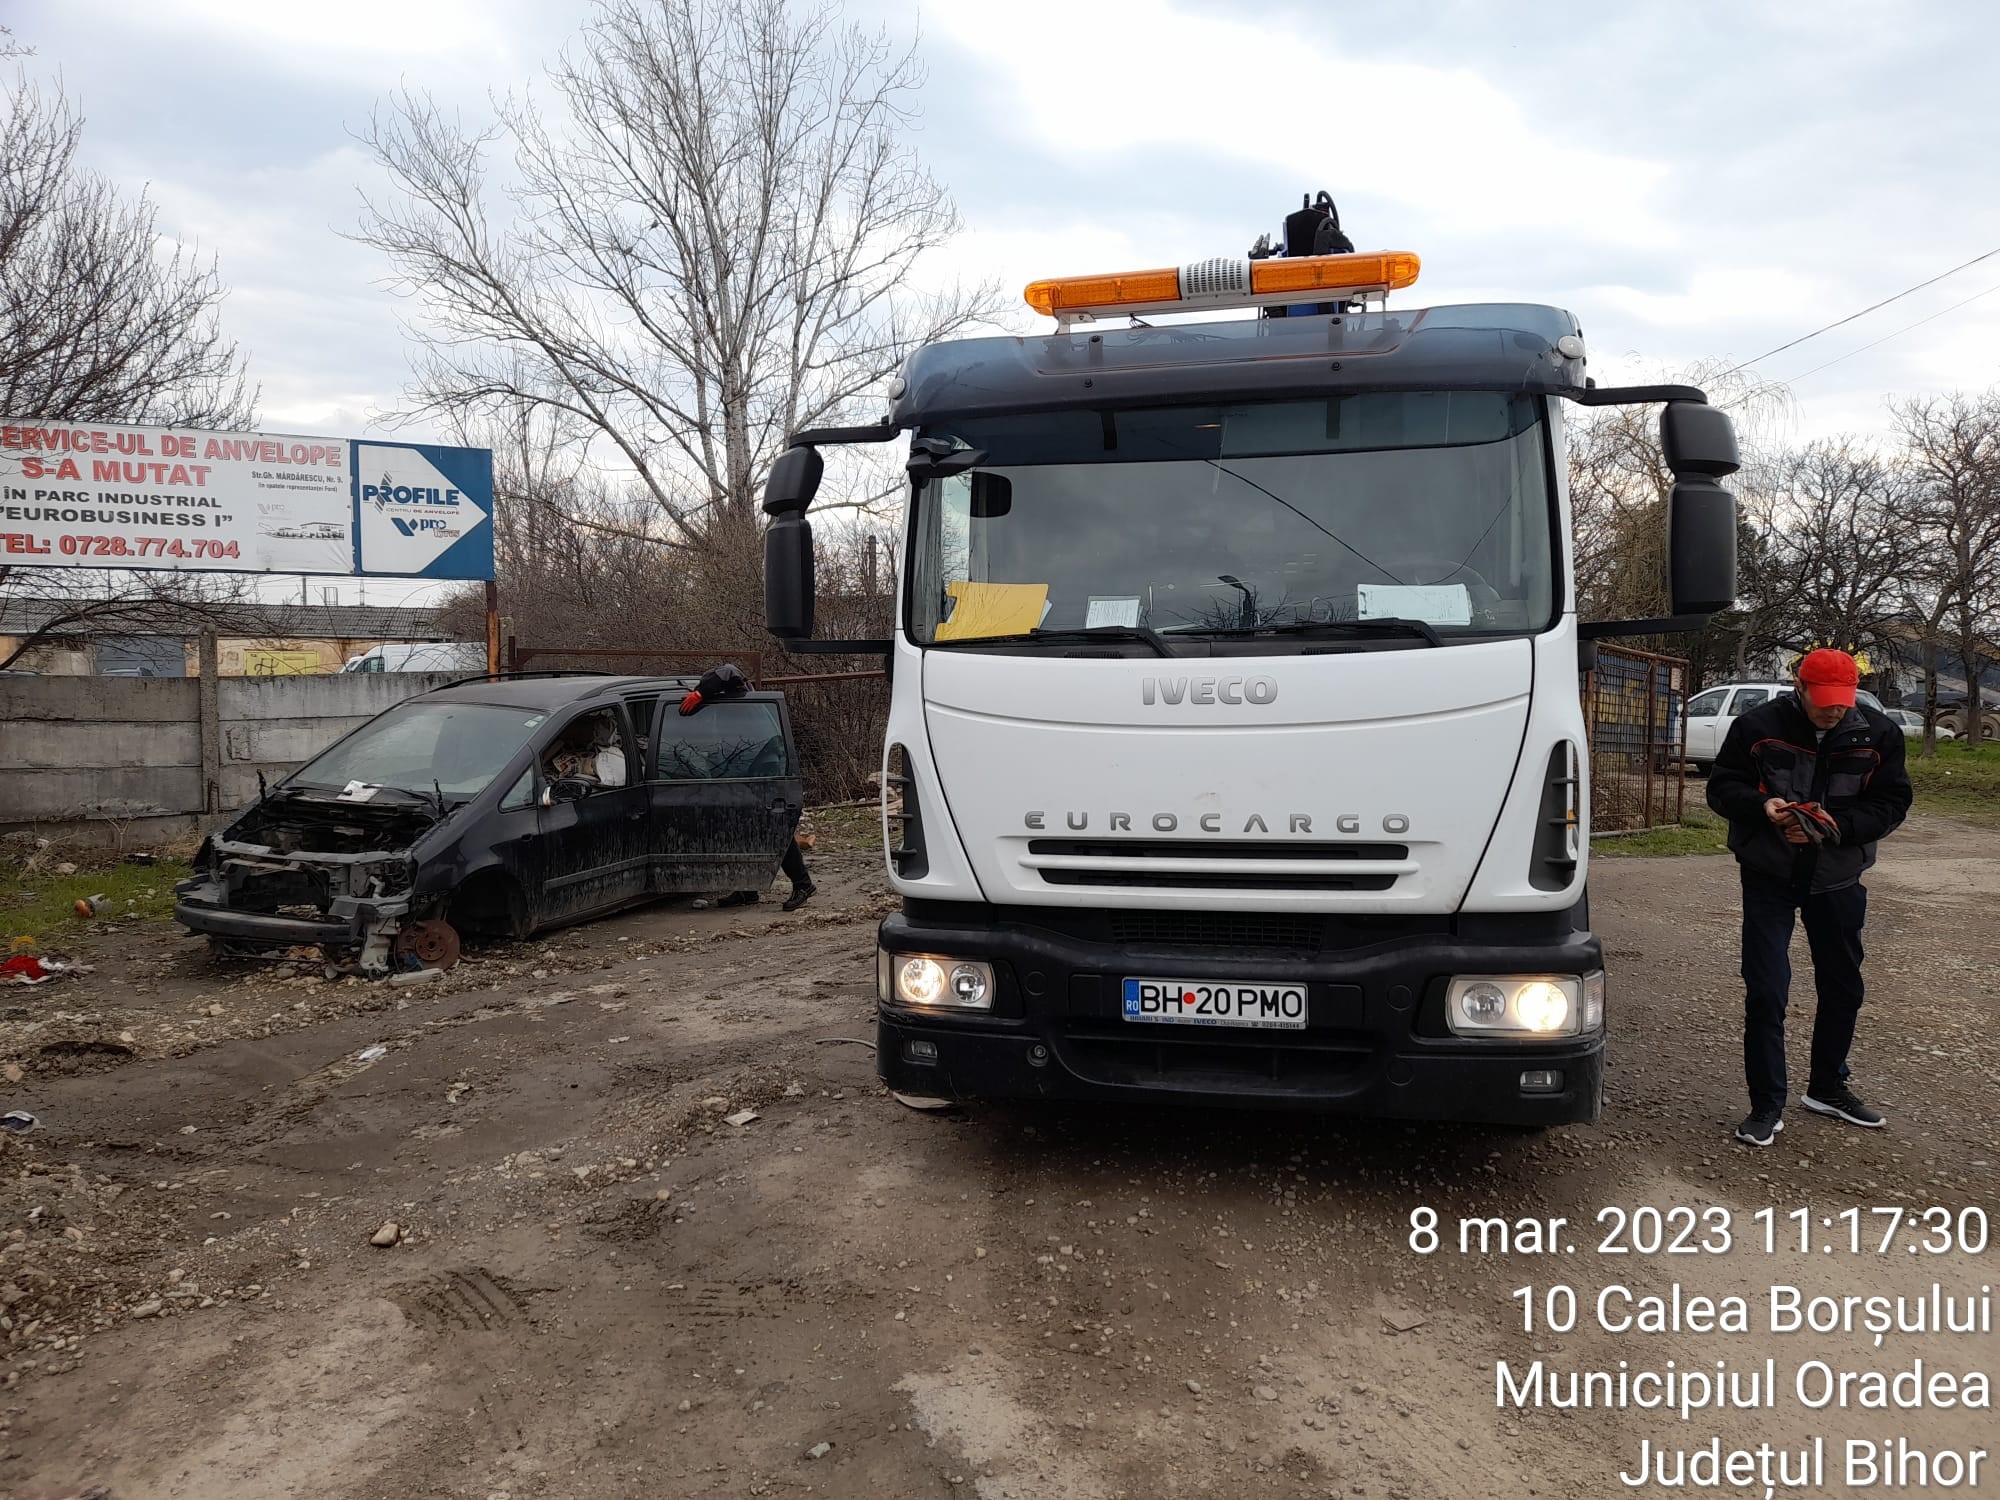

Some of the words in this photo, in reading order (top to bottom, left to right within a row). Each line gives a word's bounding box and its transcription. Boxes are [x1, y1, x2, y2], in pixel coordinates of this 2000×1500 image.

[0, 426, 154, 456] ERVICE-UL
[161, 435, 197, 458] DE
[204, 438, 342, 467] ANVELOPE
[21, 456, 82, 480] S-A
[93, 460, 211, 486] MUTAT
[3, 486, 27, 500] ÎN
[34, 489, 90, 503] PARC
[97, 492, 222, 508] INDUSTRIAL
[362, 484, 460, 506] PROFILE
[59, 534, 241, 560] 0728.774.704
[1142, 674, 1279, 706] IVECO
[1024, 810, 1411, 834] EUROCARGO
[1126, 1000, 1139, 1012] RO
[1140, 985, 1183, 1014] BH
[1195, 987, 1231, 1015] 20
[1237, 988, 1303, 1018] PMO
[1193, 1017, 1218, 1025] IVECO
